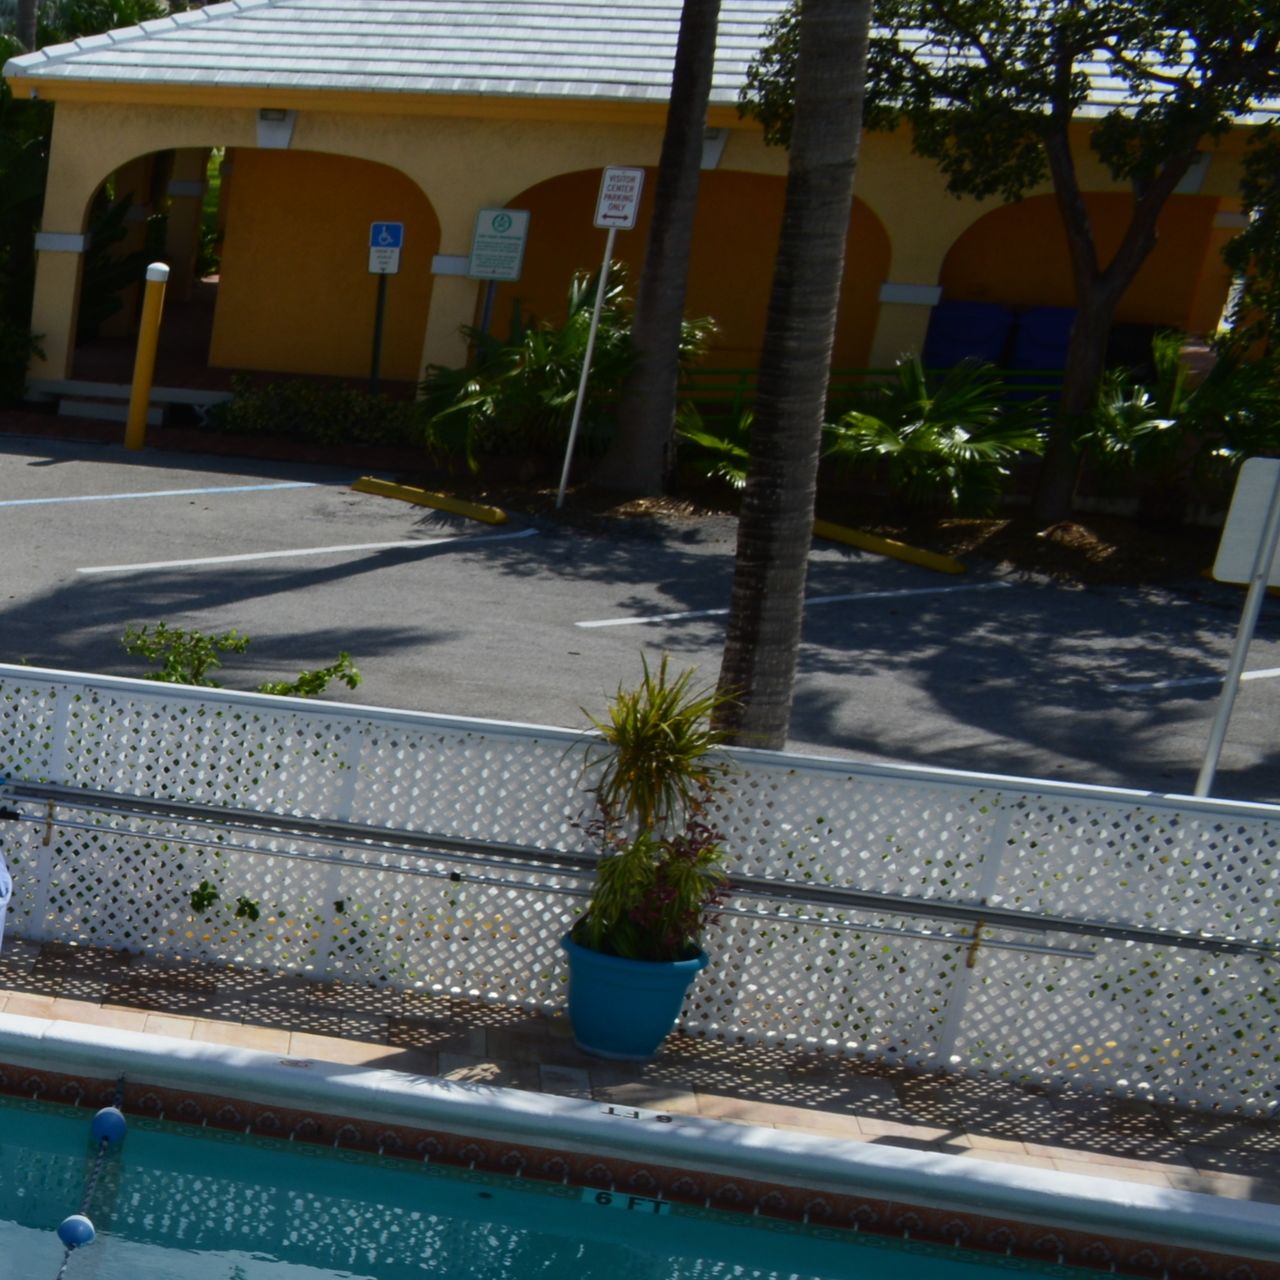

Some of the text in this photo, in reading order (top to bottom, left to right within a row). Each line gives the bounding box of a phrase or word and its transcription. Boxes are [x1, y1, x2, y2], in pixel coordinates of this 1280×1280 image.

[608, 175, 636, 183] VISITOR
[607, 184, 634, 193] CENTER
[604, 193, 633, 202] PARKING
[608, 202, 625, 211] ONLY
[594, 1191, 669, 1214] 6 FT
